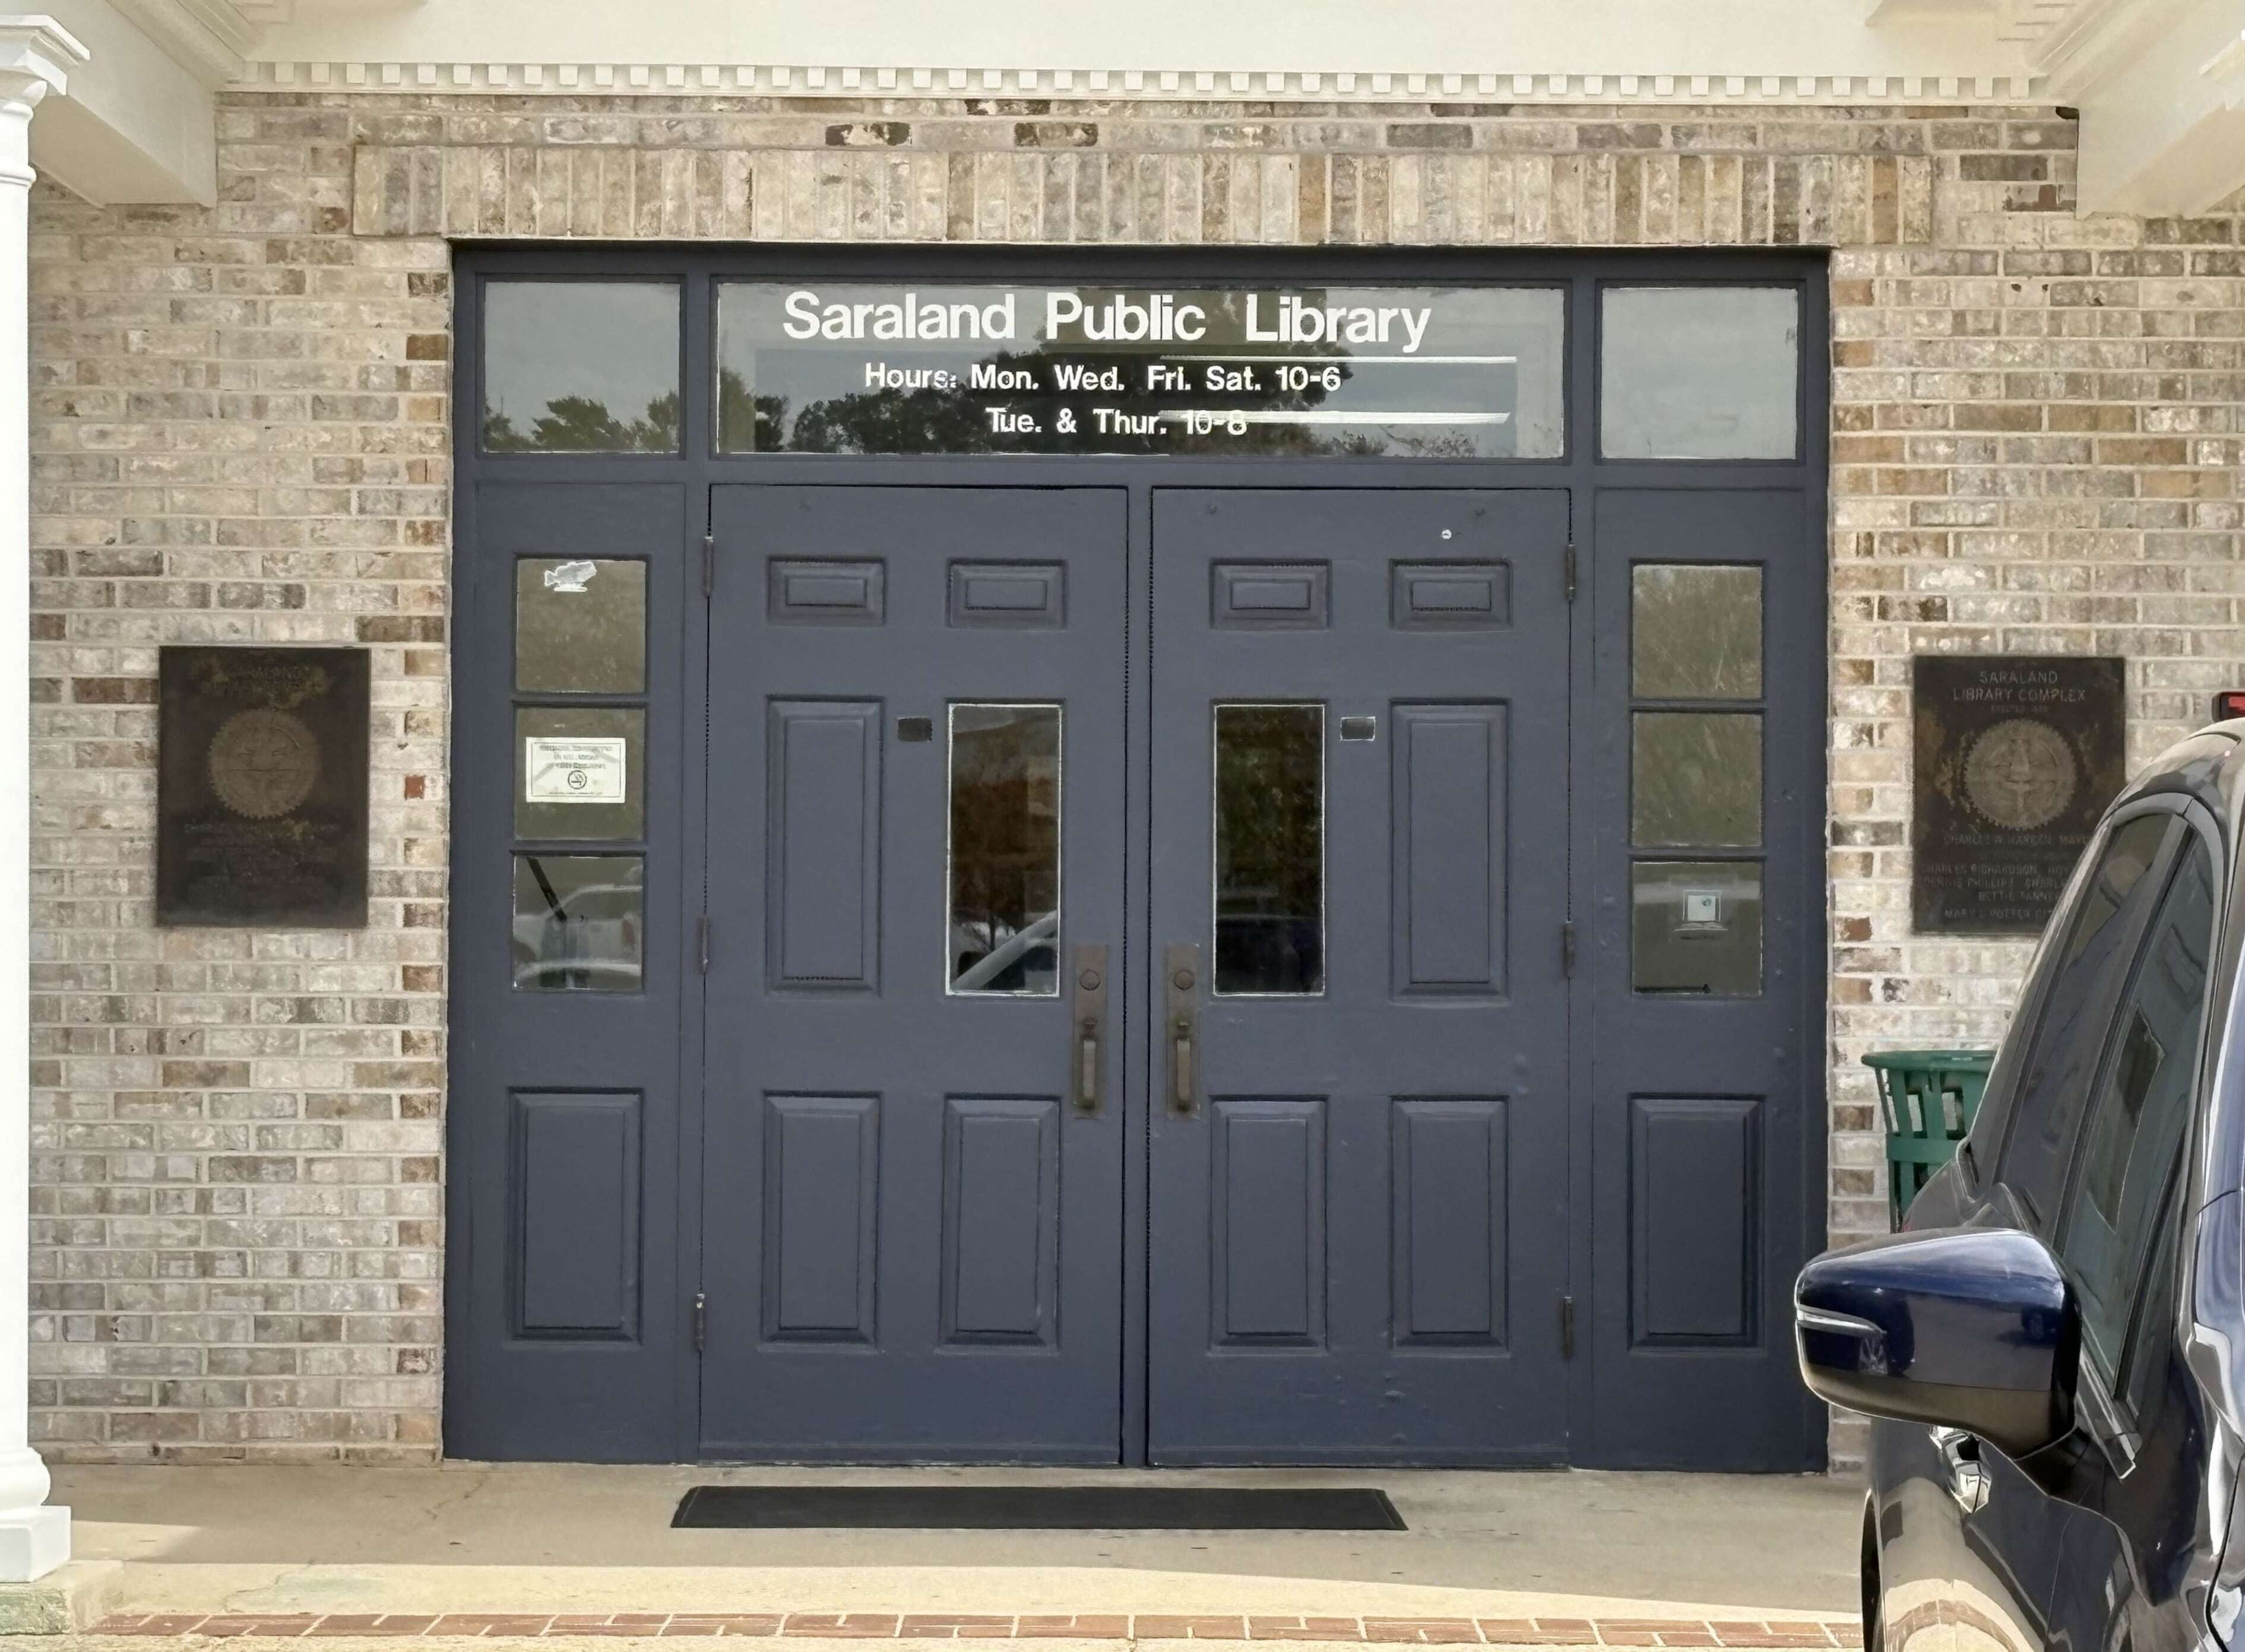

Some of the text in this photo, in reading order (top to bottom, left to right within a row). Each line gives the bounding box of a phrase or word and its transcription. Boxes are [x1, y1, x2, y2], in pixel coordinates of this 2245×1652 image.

[783, 291, 1432, 353] Saraland Public Library
[865, 362, 1341, 392] Hours: Mon. Wed. Fri. Sat. 10-6
[984, 407, 1247, 436] Tue. & Thur. 10-8
[1979, 670, 2058, 684] SARALAND
[1953, 687, 2086, 702] LIBRARY COMPLEX
